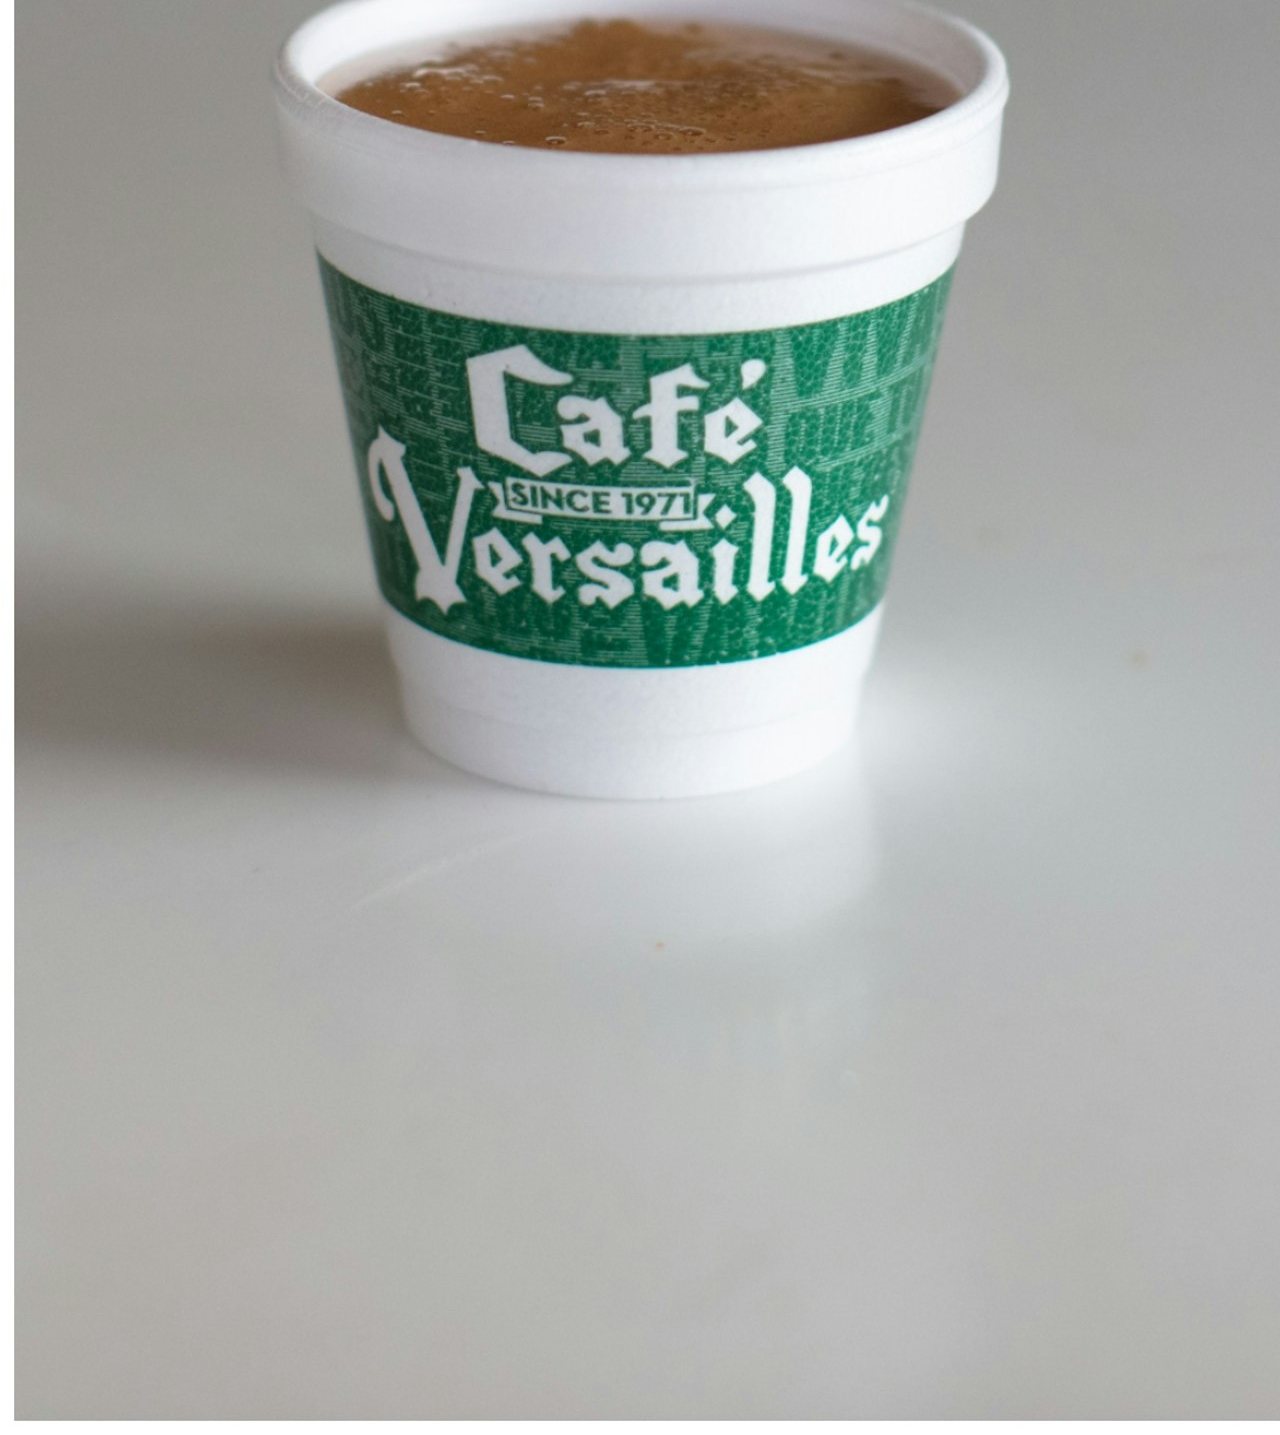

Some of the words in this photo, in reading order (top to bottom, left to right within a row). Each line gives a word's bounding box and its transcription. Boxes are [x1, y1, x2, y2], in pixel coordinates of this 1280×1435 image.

[466, 343, 766, 476] Café
[368, 425, 889, 615] Versailles
[511, 482, 612, 514] SINCE
[621, 492, 691, 515] 1971
